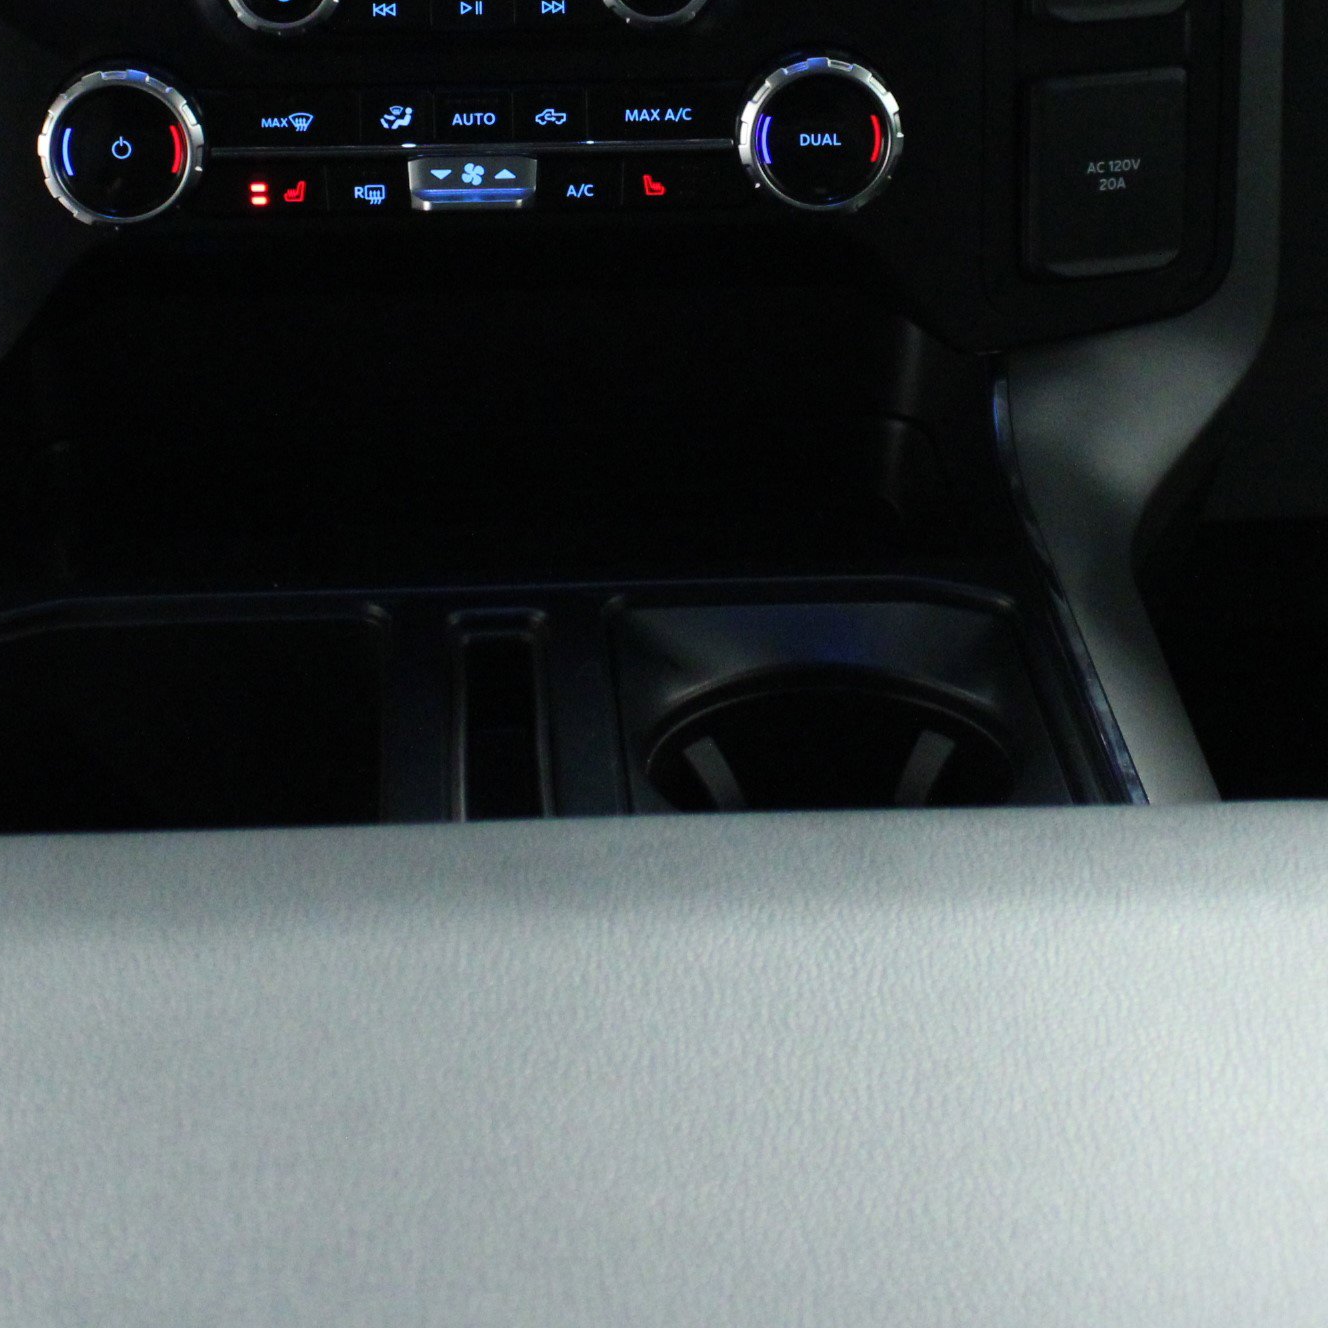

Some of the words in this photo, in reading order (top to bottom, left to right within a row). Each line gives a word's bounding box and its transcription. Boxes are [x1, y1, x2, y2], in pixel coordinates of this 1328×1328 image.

[451, 112, 497, 127] AUTO
[624, 108, 662, 123] MAX
[664, 106, 693, 123] A/C
[260, 117, 289, 129] MAX
[798, 132, 842, 147] DUAL
[1086, 161, 1106, 175] AC
[1108, 157, 1141, 172] 120V
[566, 183, 595, 199] A/C
[1099, 176, 1127, 191] 20A
